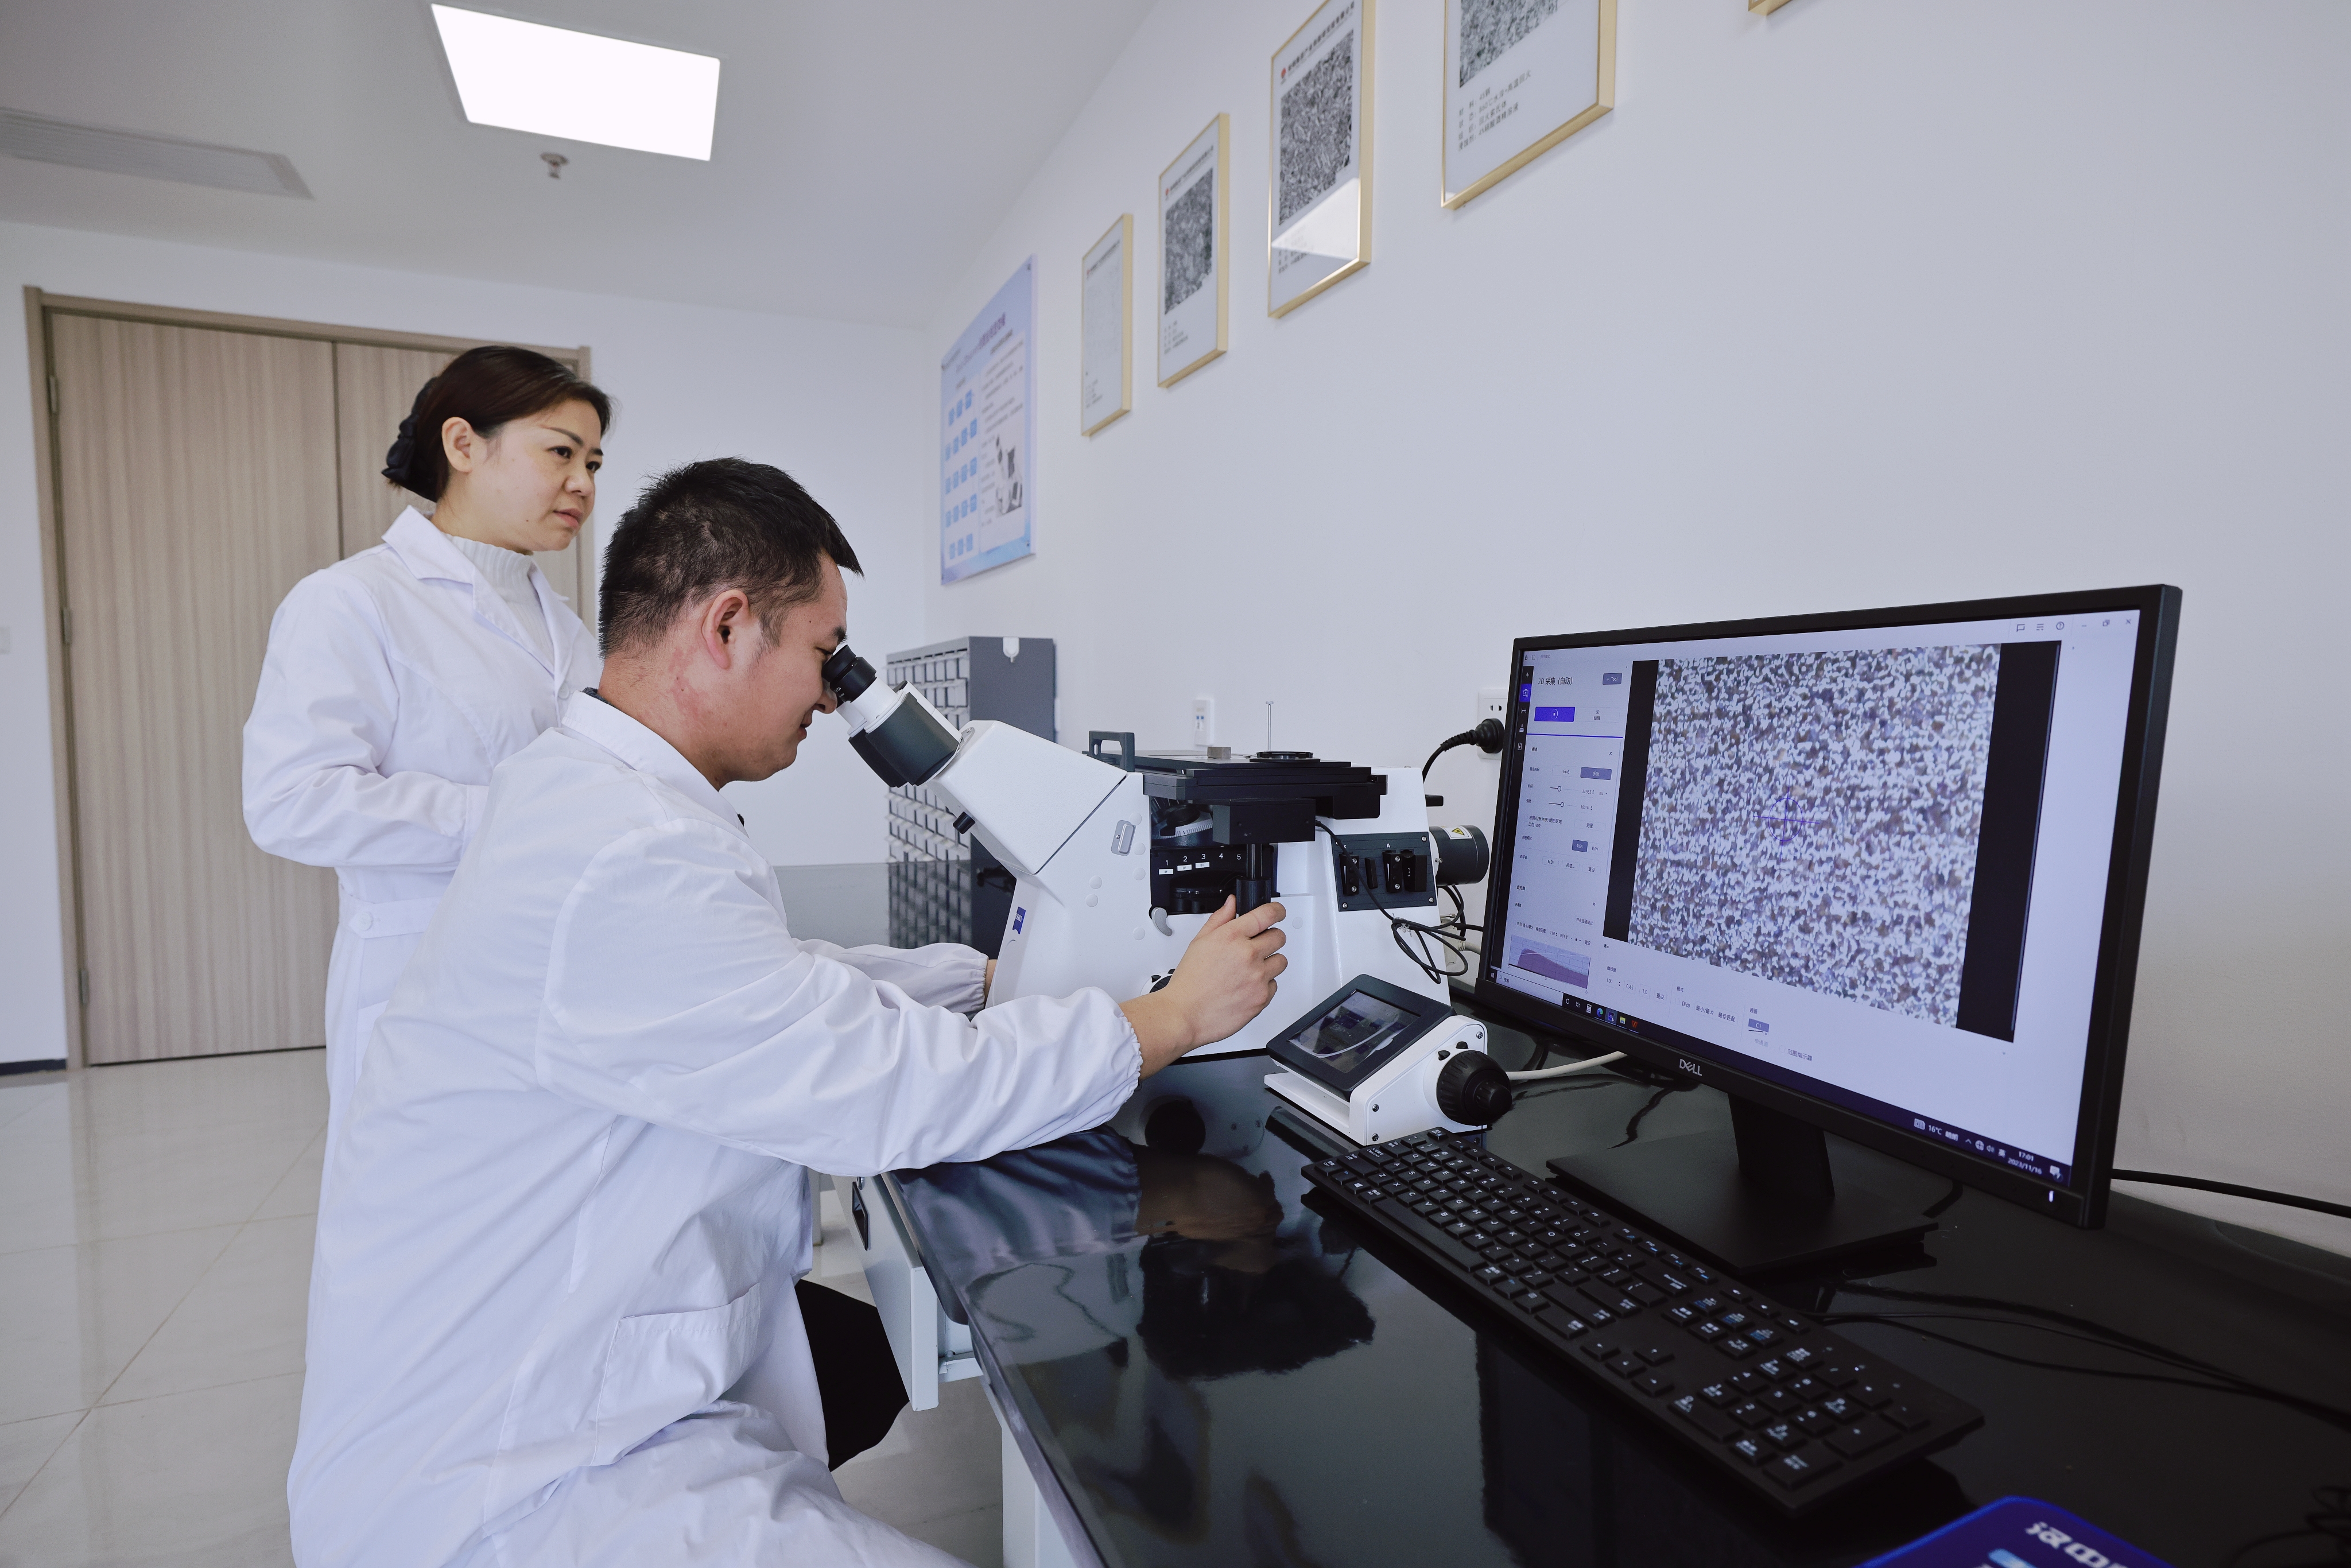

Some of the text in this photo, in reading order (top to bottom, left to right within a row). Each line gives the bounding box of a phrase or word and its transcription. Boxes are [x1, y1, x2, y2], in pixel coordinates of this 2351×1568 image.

[1696, 1005, 1714, 1016] 最小/最大
[1718, 1012, 1736, 1023] 最佳匹配
[1787, 1048, 1813, 1062] 范围指示器
[1679, 1058, 1702, 1076] DELL
